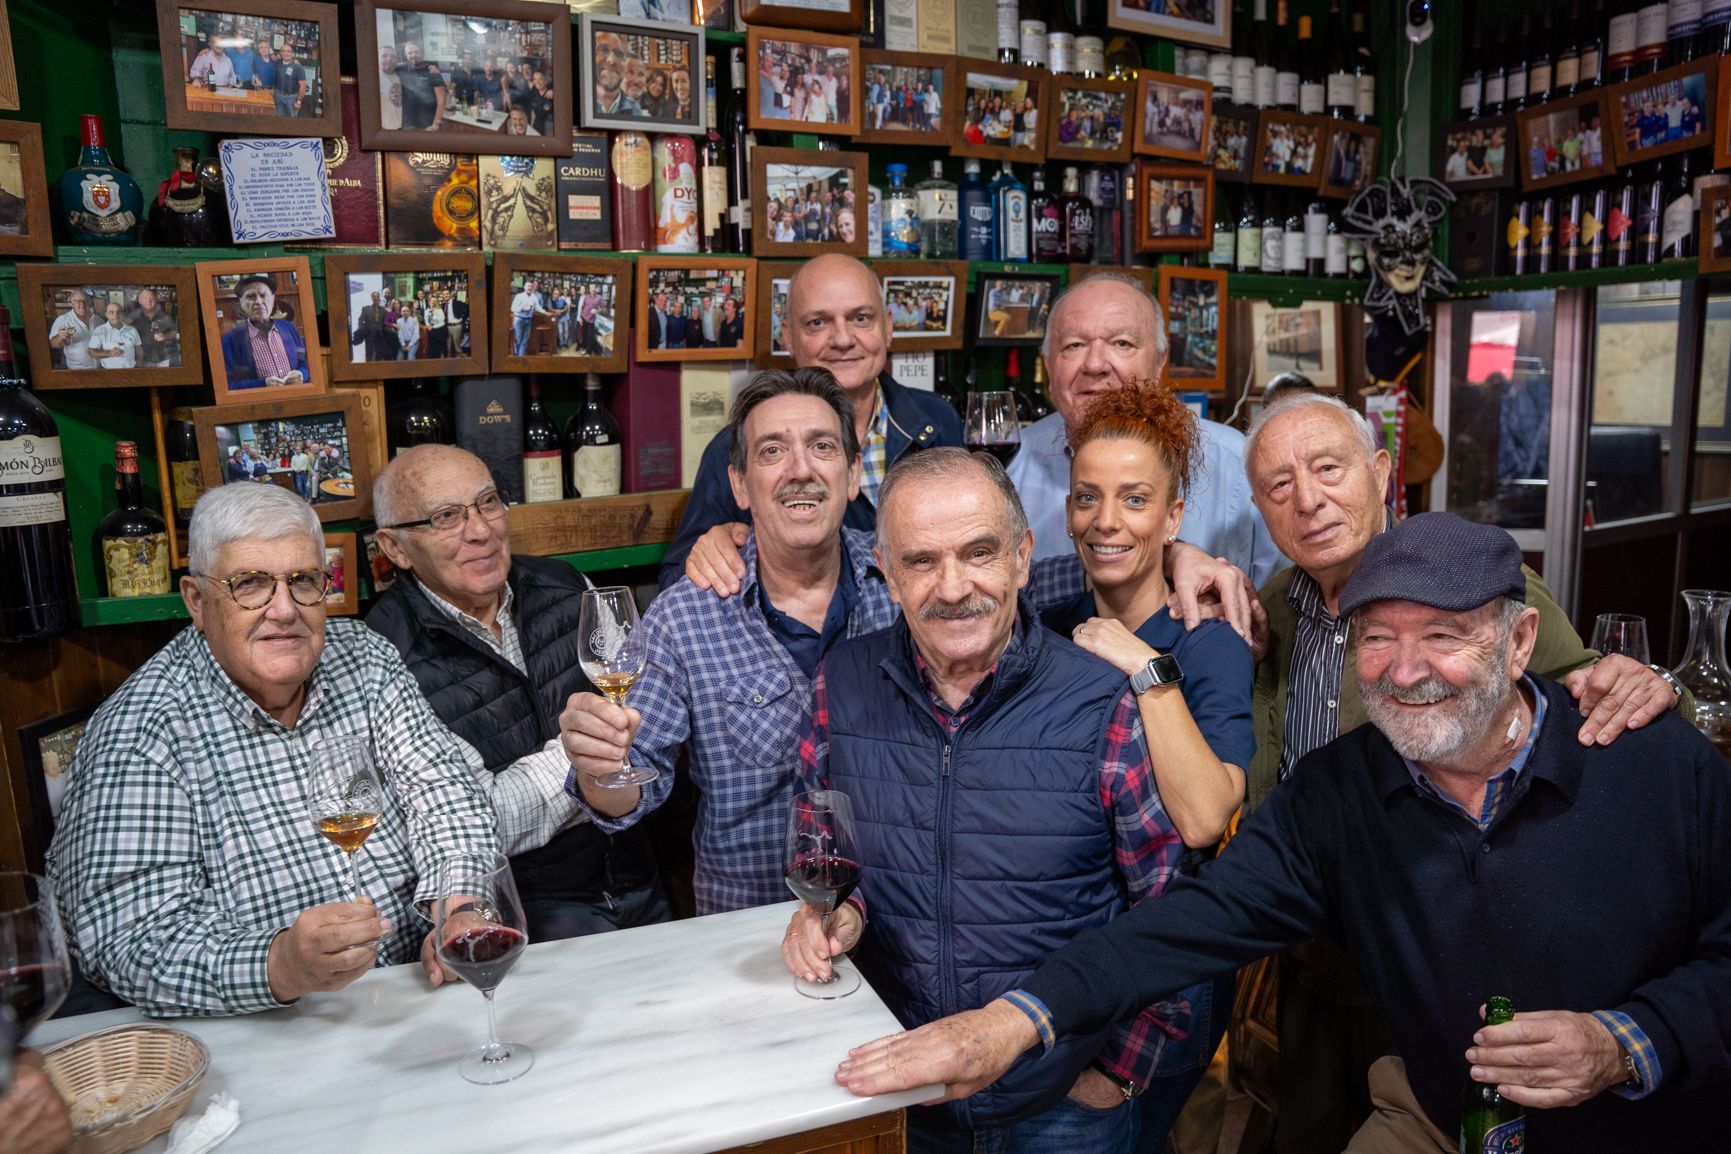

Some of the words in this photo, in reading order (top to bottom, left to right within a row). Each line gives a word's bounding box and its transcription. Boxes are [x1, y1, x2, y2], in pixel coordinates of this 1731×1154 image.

[560, 166, 606, 178] CARDHU
[899, 364, 929, 377] PEPE
[479, 414, 512, 425] DOW'S
[0, 458, 29, 471] MÓN
